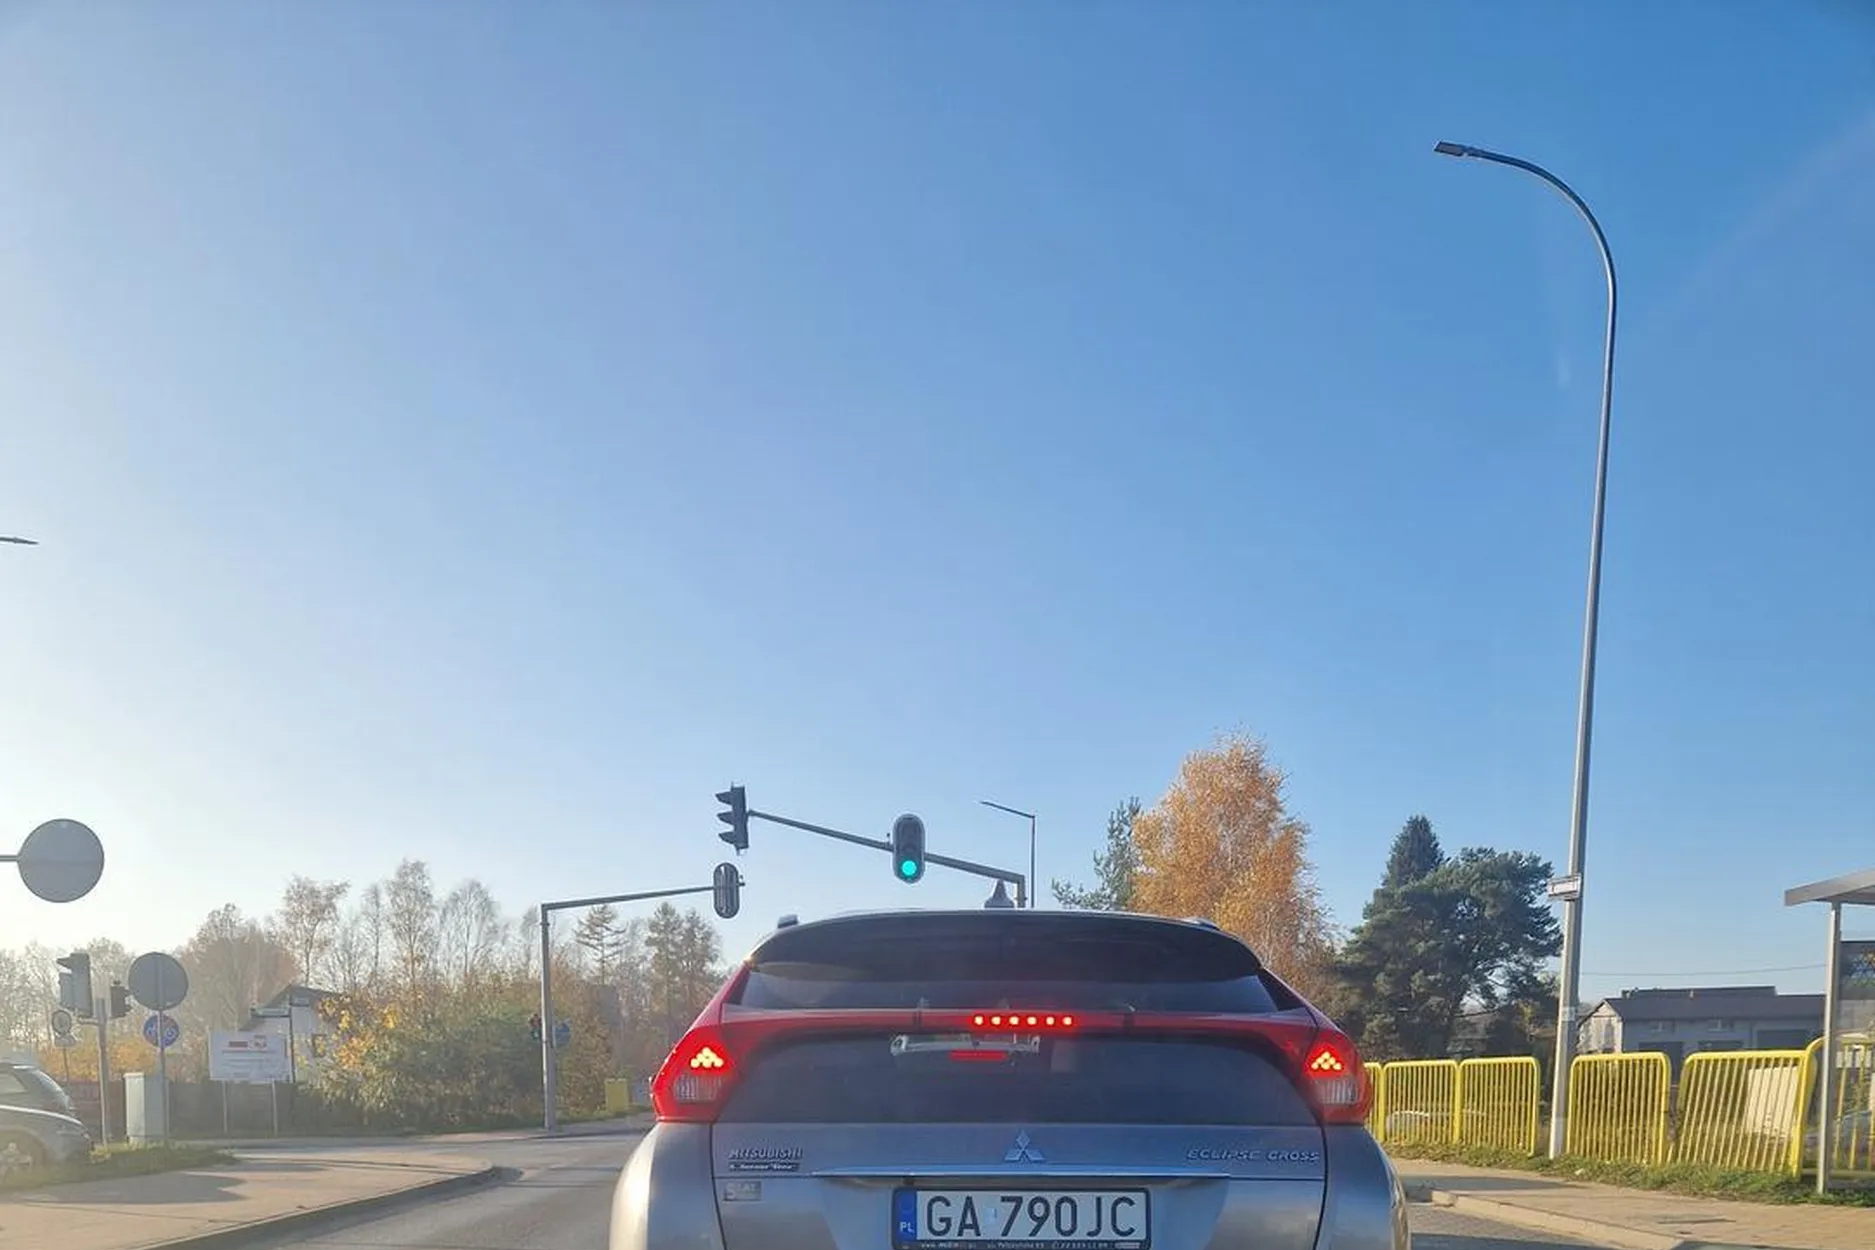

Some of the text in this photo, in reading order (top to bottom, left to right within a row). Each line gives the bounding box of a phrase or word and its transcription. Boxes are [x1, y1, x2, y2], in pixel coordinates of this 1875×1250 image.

[728, 1147, 804, 1159] MITSUBISHI
[1186, 1148, 1320, 1161] ECLIPSE CROSS
[926, 1195, 1137, 1238] GA 790JC
[899, 1221, 915, 1233] PL
